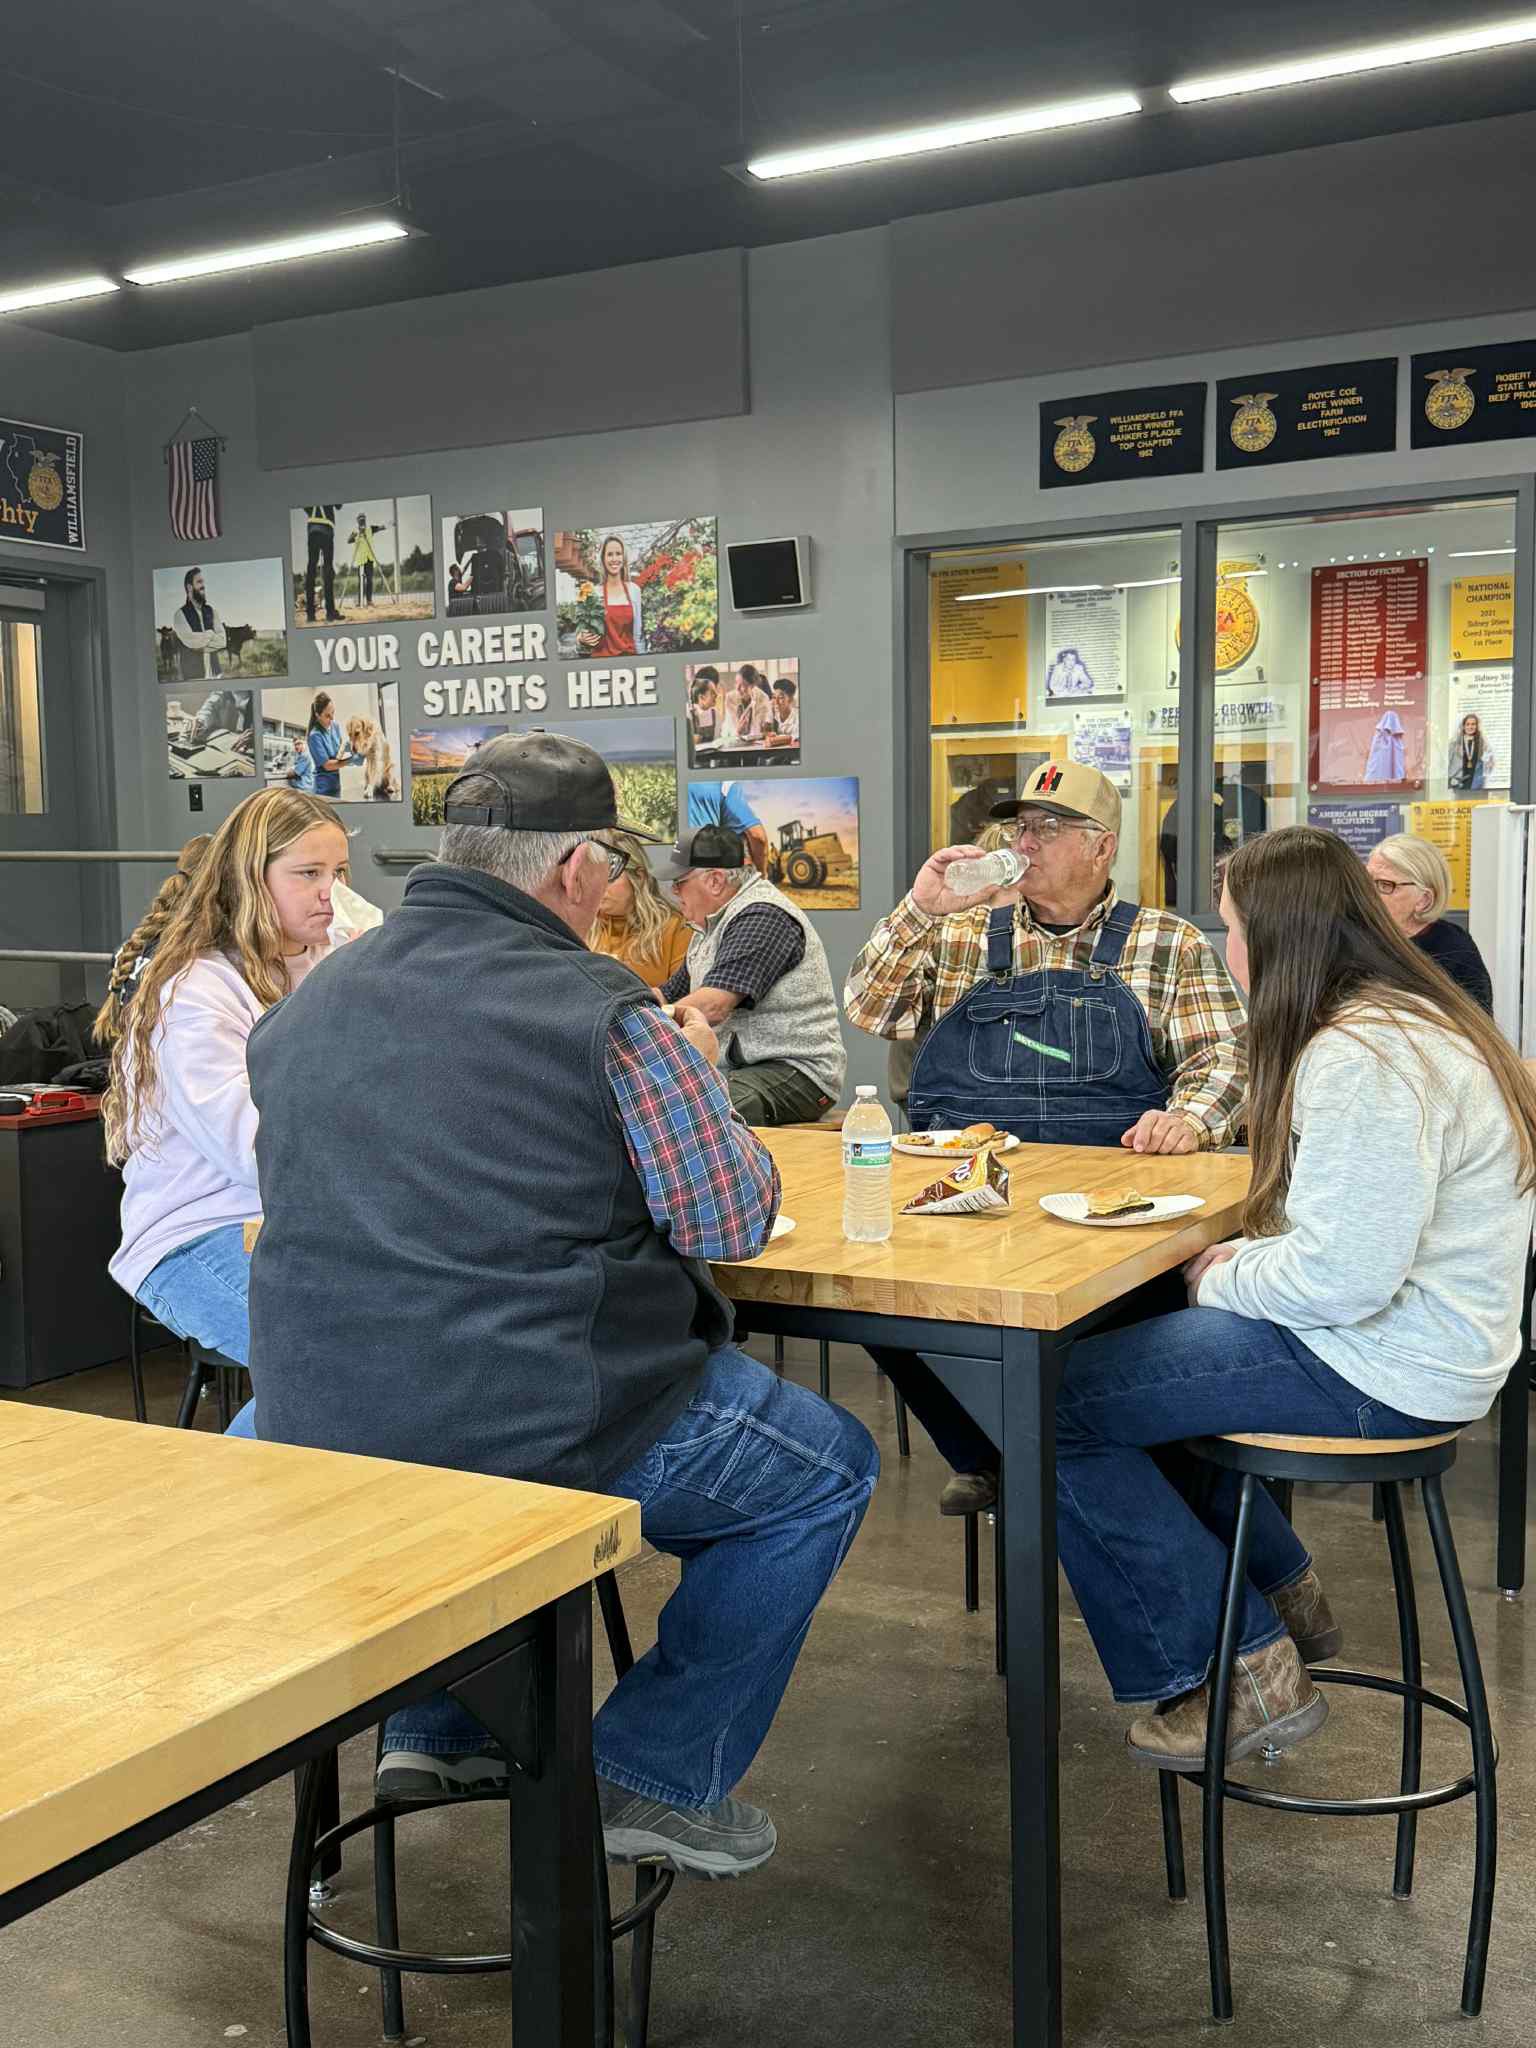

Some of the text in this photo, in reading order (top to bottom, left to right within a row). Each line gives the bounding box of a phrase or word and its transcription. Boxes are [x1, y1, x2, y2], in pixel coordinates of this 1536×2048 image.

[1496, 371, 1531, 382] ROBERT
[1308, 387, 1357, 400] ROYCE COE
[1497, 382, 1525, 392] STATE
[1302, 397, 1363, 411] STATE WINNER
[1488, 393, 1510, 402] BEEF
[1110, 410, 1184, 425] WILLIAMSFIELD FFA
[1320, 409, 1344, 418] FARM
[1119, 420, 1174, 433] STATE WINNER
[1297, 415, 1367, 430] ELECTRIFICATION
[1110, 428, 1182, 443] BANKER'S PLAQUE
[1120, 438, 1173, 450] TOP CHAPTER
[66, 435, 80, 544] WILLIAMSFIELD
[0, 497, 39, 534] hty
[1370, 566, 1405, 576] OFFICERS
[1468, 582, 1510, 592] NATIONAL
[1466, 592, 1511, 603] CHAMPION
[313, 623, 548, 674] YOUR CAREER
[423, 666, 658, 717] STARTS HERE
[1222, 702, 1272, 716] GROWTH
[1318, 808, 1389, 818] AMERICAN DEGREE
[1332, 816, 1375, 825] RECIPIENTS
